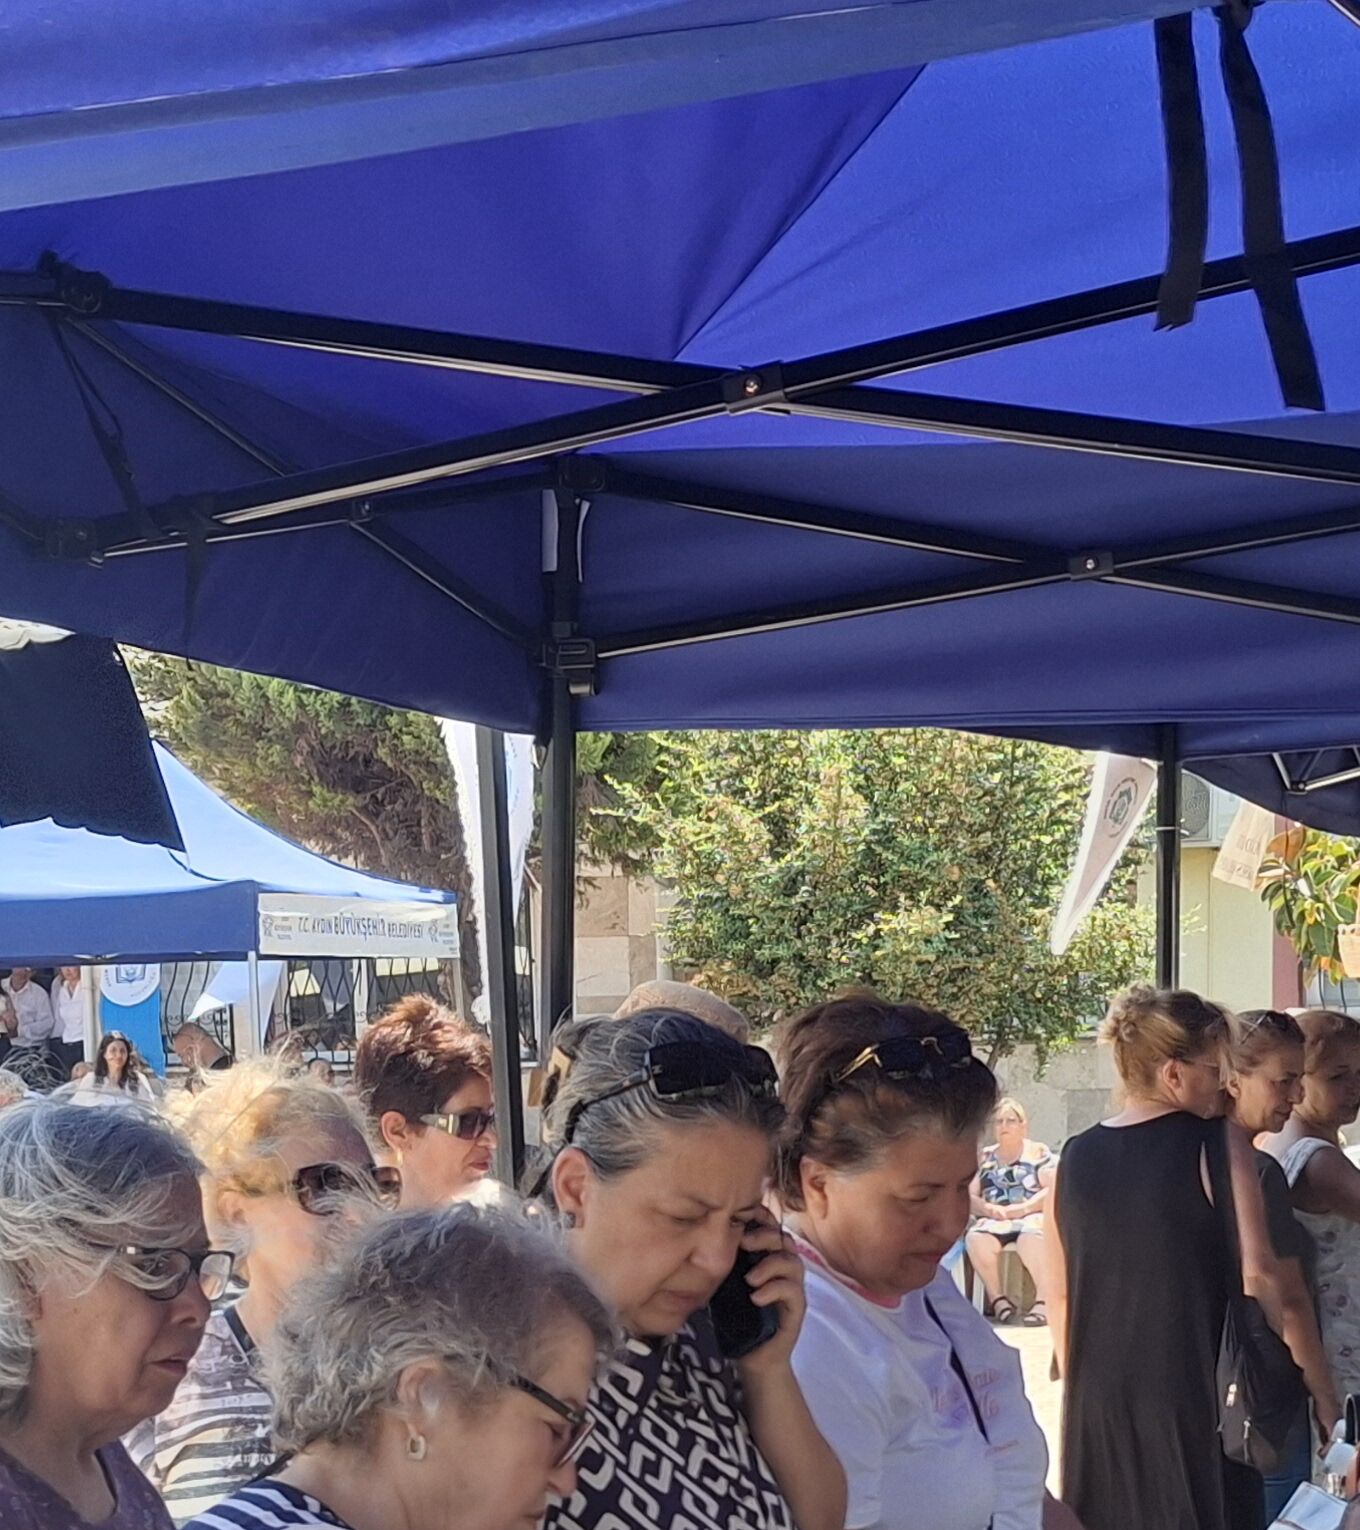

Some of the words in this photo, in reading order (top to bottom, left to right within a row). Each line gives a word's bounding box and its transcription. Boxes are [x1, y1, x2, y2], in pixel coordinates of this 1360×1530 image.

[311, 917, 333, 935] AYDIN
[333, 912, 387, 940] BÜYÜKŞEHİR
[387, 921, 424, 938] BELEDİYESİ
